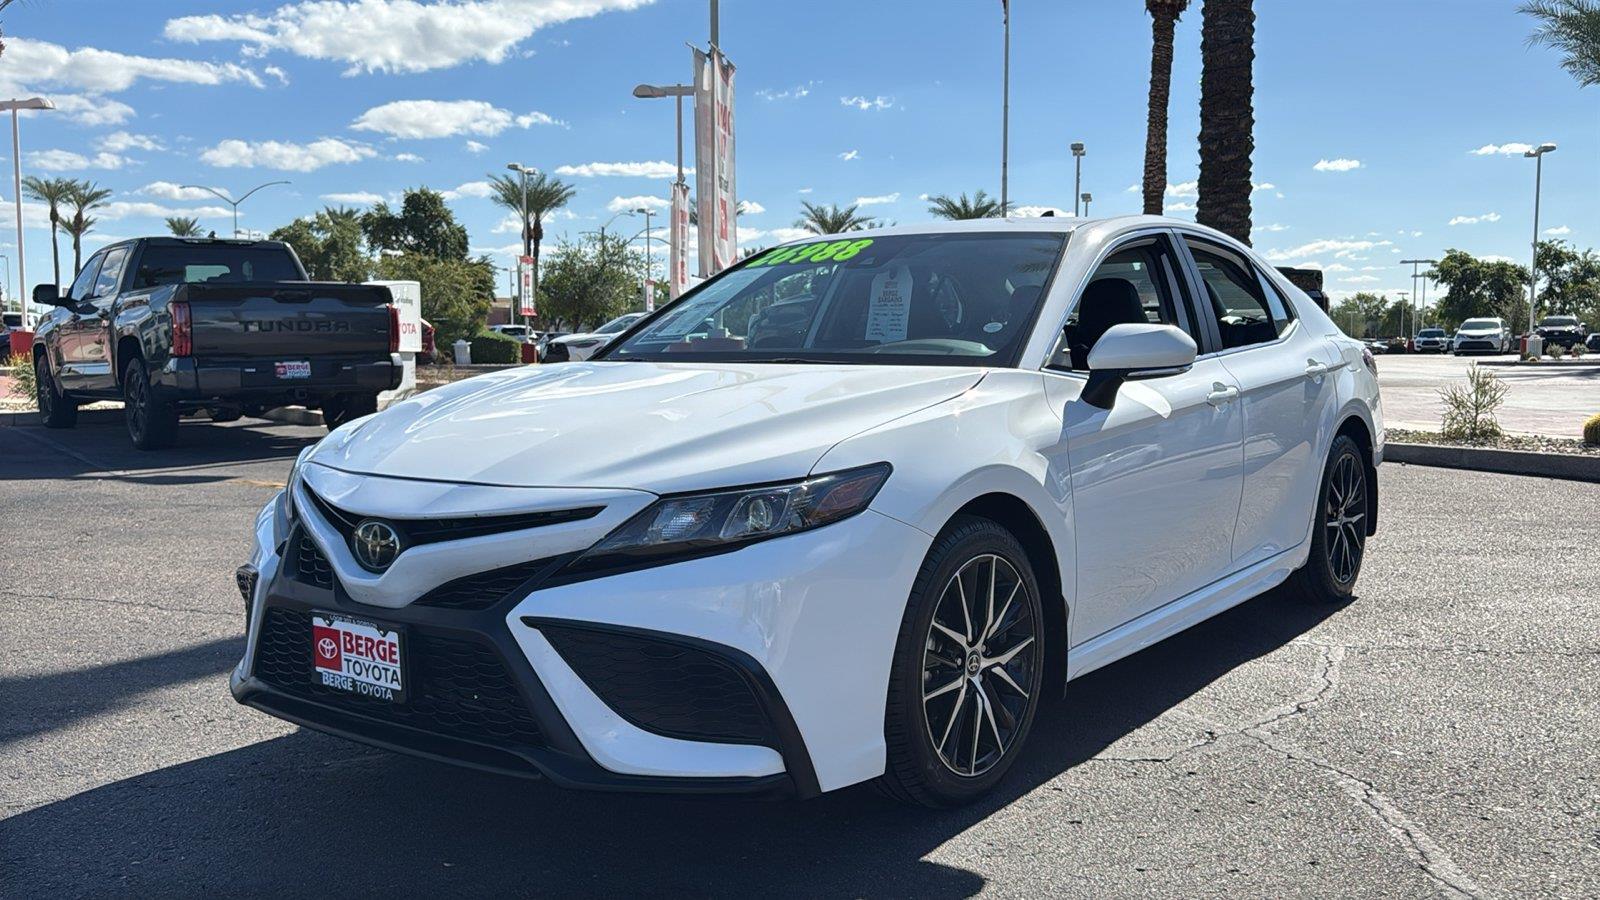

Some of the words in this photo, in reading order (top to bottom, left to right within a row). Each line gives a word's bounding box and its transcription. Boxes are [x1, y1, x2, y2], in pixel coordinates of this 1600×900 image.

[745, 239, 874, 267] 26988
[239, 319, 350, 332] TUNDRA
[401, 322, 417, 335] OTA
[342, 631, 398, 664] BERGE
[322, 671, 354, 691] BERGE
[356, 681, 394, 700] TOYOTA
[343, 658, 400, 686] TOYOTA
